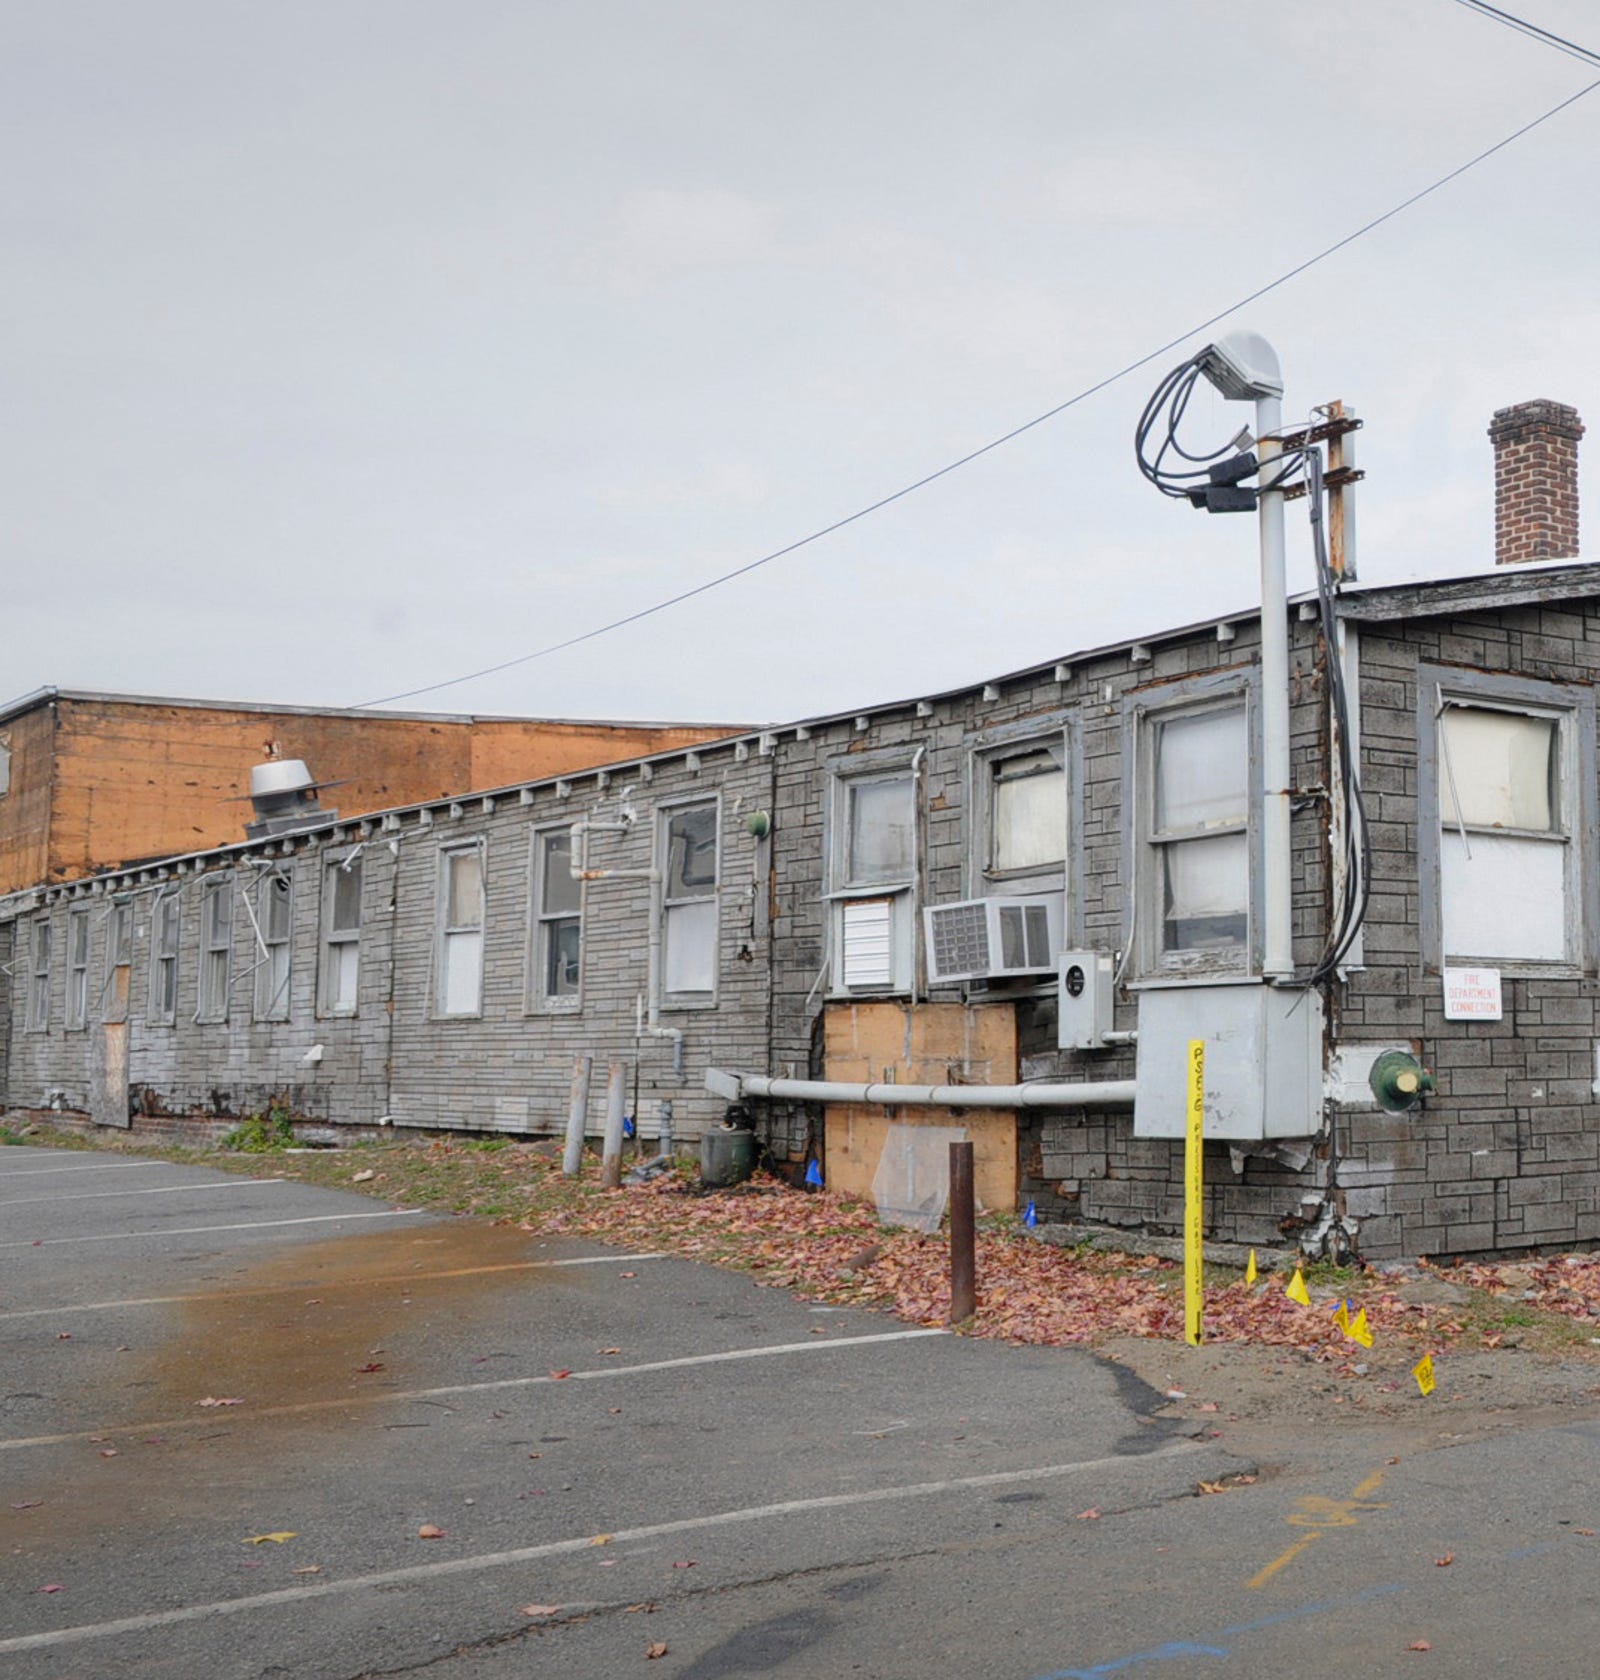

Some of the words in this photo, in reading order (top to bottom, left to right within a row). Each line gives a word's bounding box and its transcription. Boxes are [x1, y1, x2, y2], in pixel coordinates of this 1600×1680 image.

[1464, 974, 1480, 985] FIRE
[1449, 987, 1497, 1000] DEPARTMENT
[1451, 1001, 1498, 1013] CONNECTION
